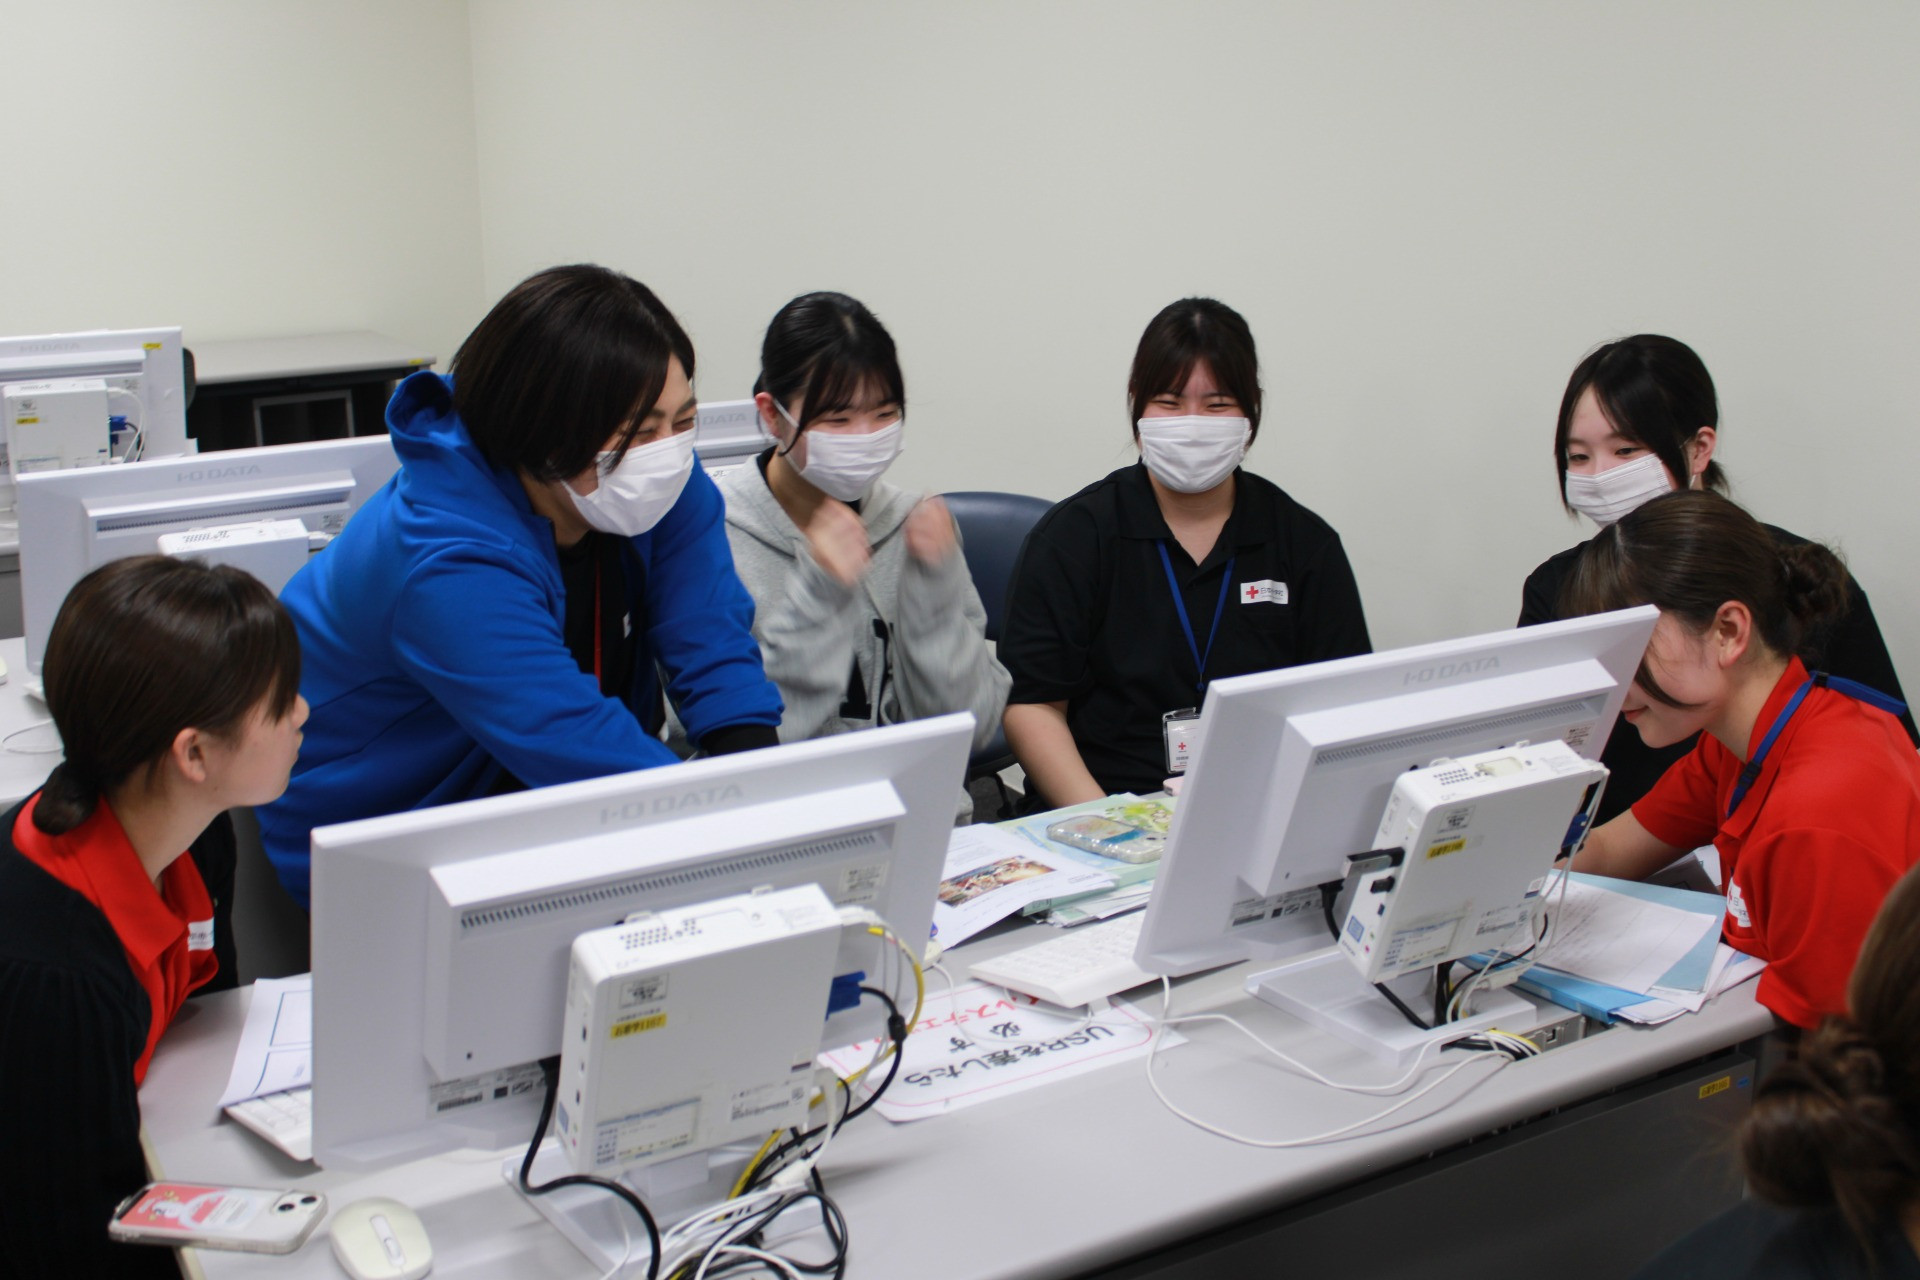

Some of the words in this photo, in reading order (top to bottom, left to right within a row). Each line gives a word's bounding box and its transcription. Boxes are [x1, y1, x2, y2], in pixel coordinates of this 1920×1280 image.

[703, 412, 747, 425] DATA
[208, 464, 263, 479] DATA
[1438, 655, 1500, 679] DATA
[651, 783, 744, 815] DATA
